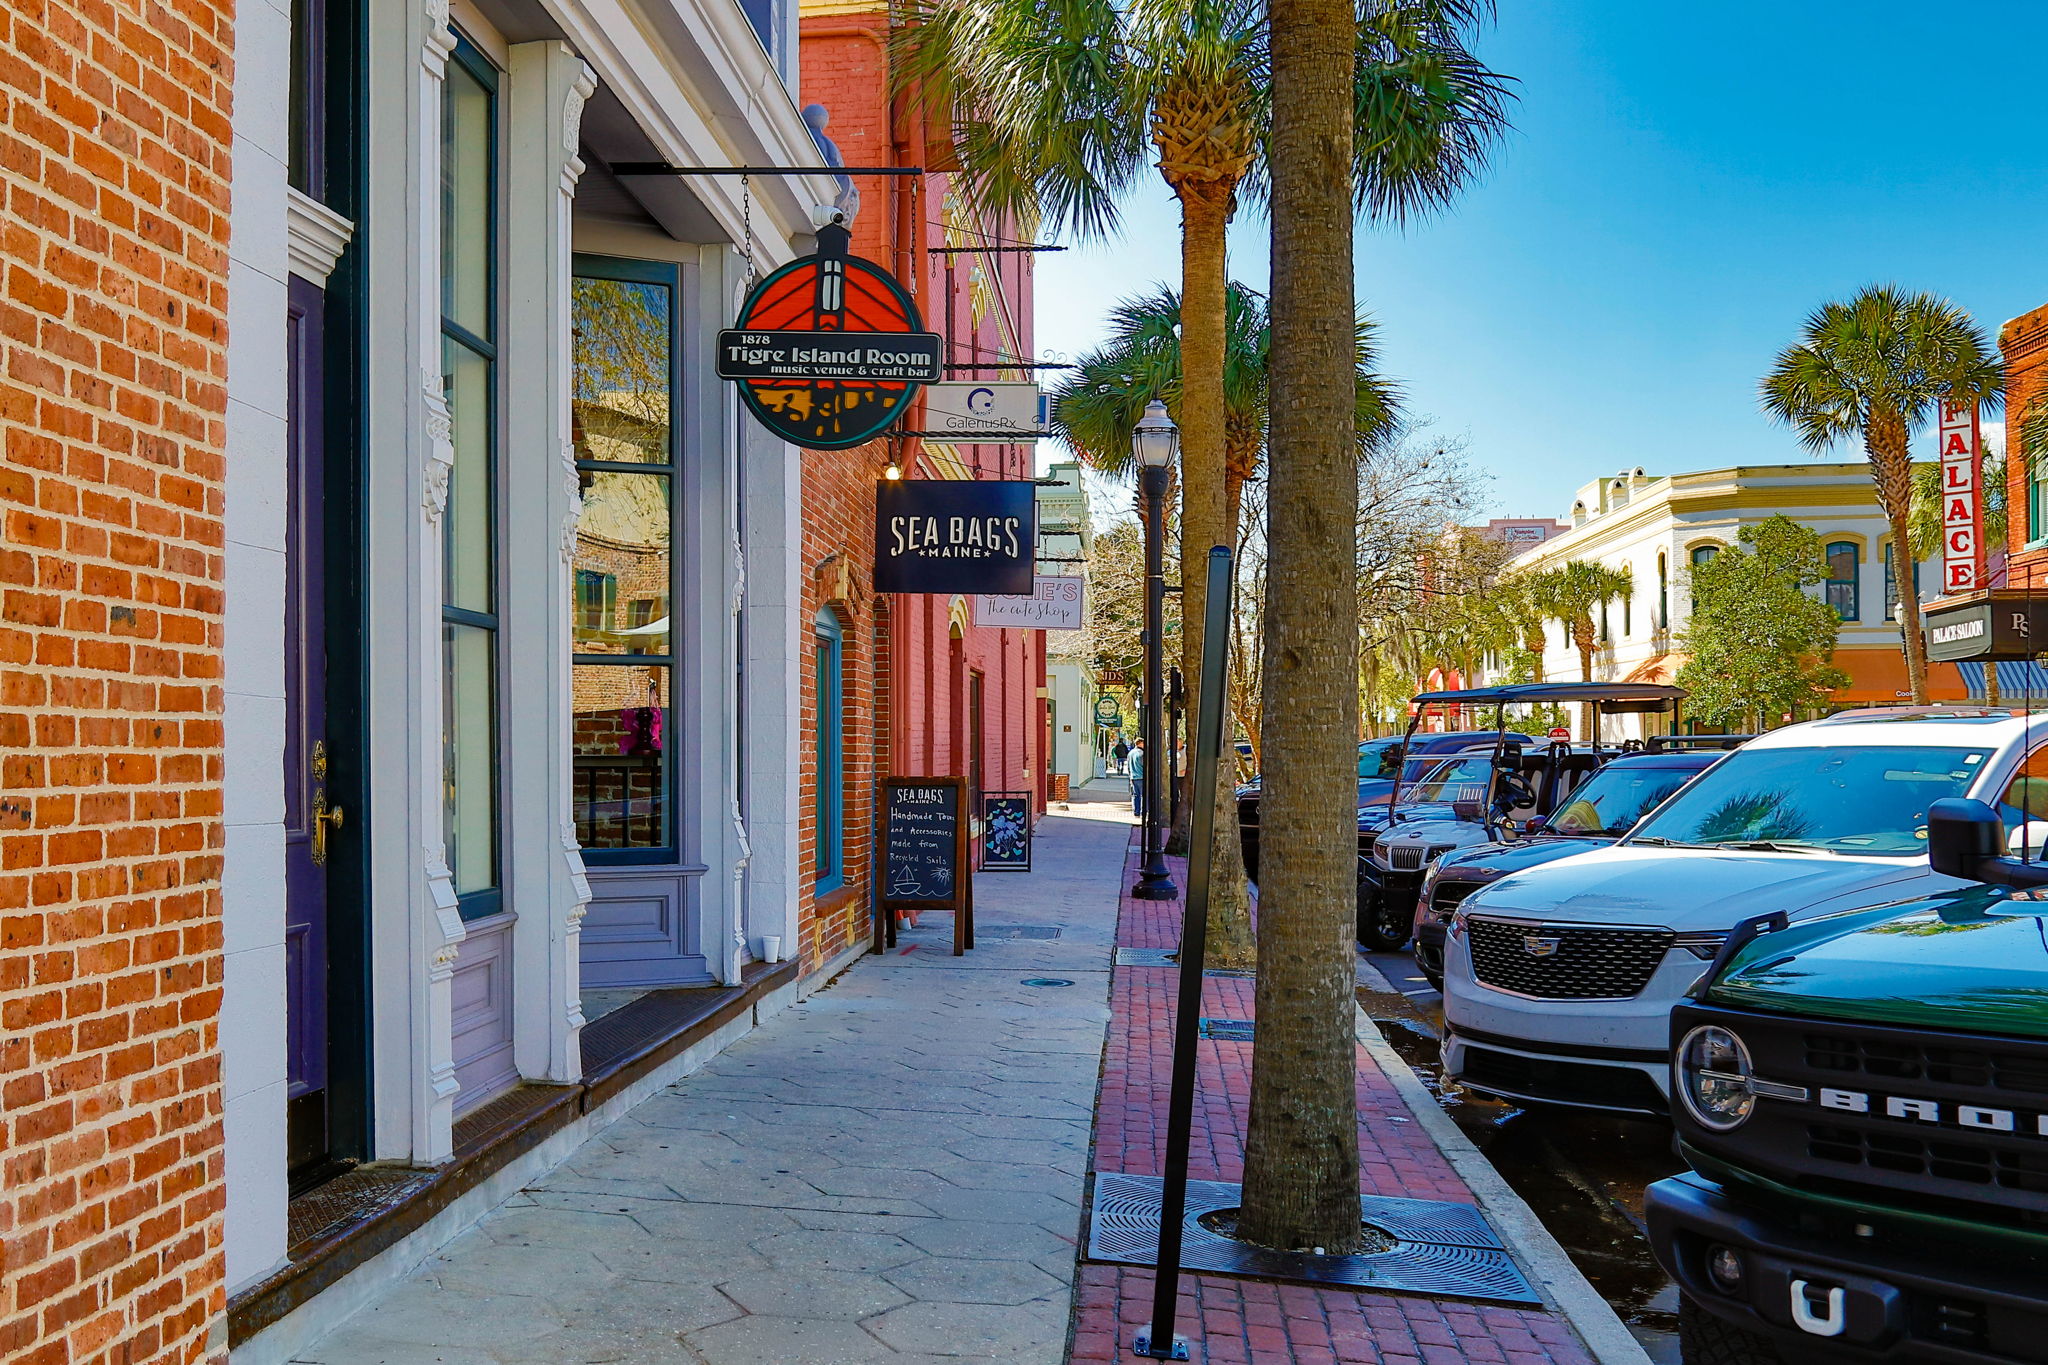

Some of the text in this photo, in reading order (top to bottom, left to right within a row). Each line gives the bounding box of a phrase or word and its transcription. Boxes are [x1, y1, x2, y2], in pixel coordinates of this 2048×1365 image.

[741, 335, 770, 344] 1878
[728, 346, 931, 366] Tigre Island Room
[771, 365, 931, 377] music venue & craft bar
[946, 417, 1017, 429] GalenusRx
[1943, 401, 1973, 587] PALACE
[890, 516, 1020, 559] SEA BAGS
[928, 547, 981, 558] MAINE
[1932, 619, 1984, 645] PALACE SALOON
[896, 788, 944, 804] SEA BAGS
[890, 807, 933, 822] Handmade
[891, 839, 911, 848] made
[889, 852, 947, 865] Recycled Sails
[1820, 1087, 2048, 1136] BRO
